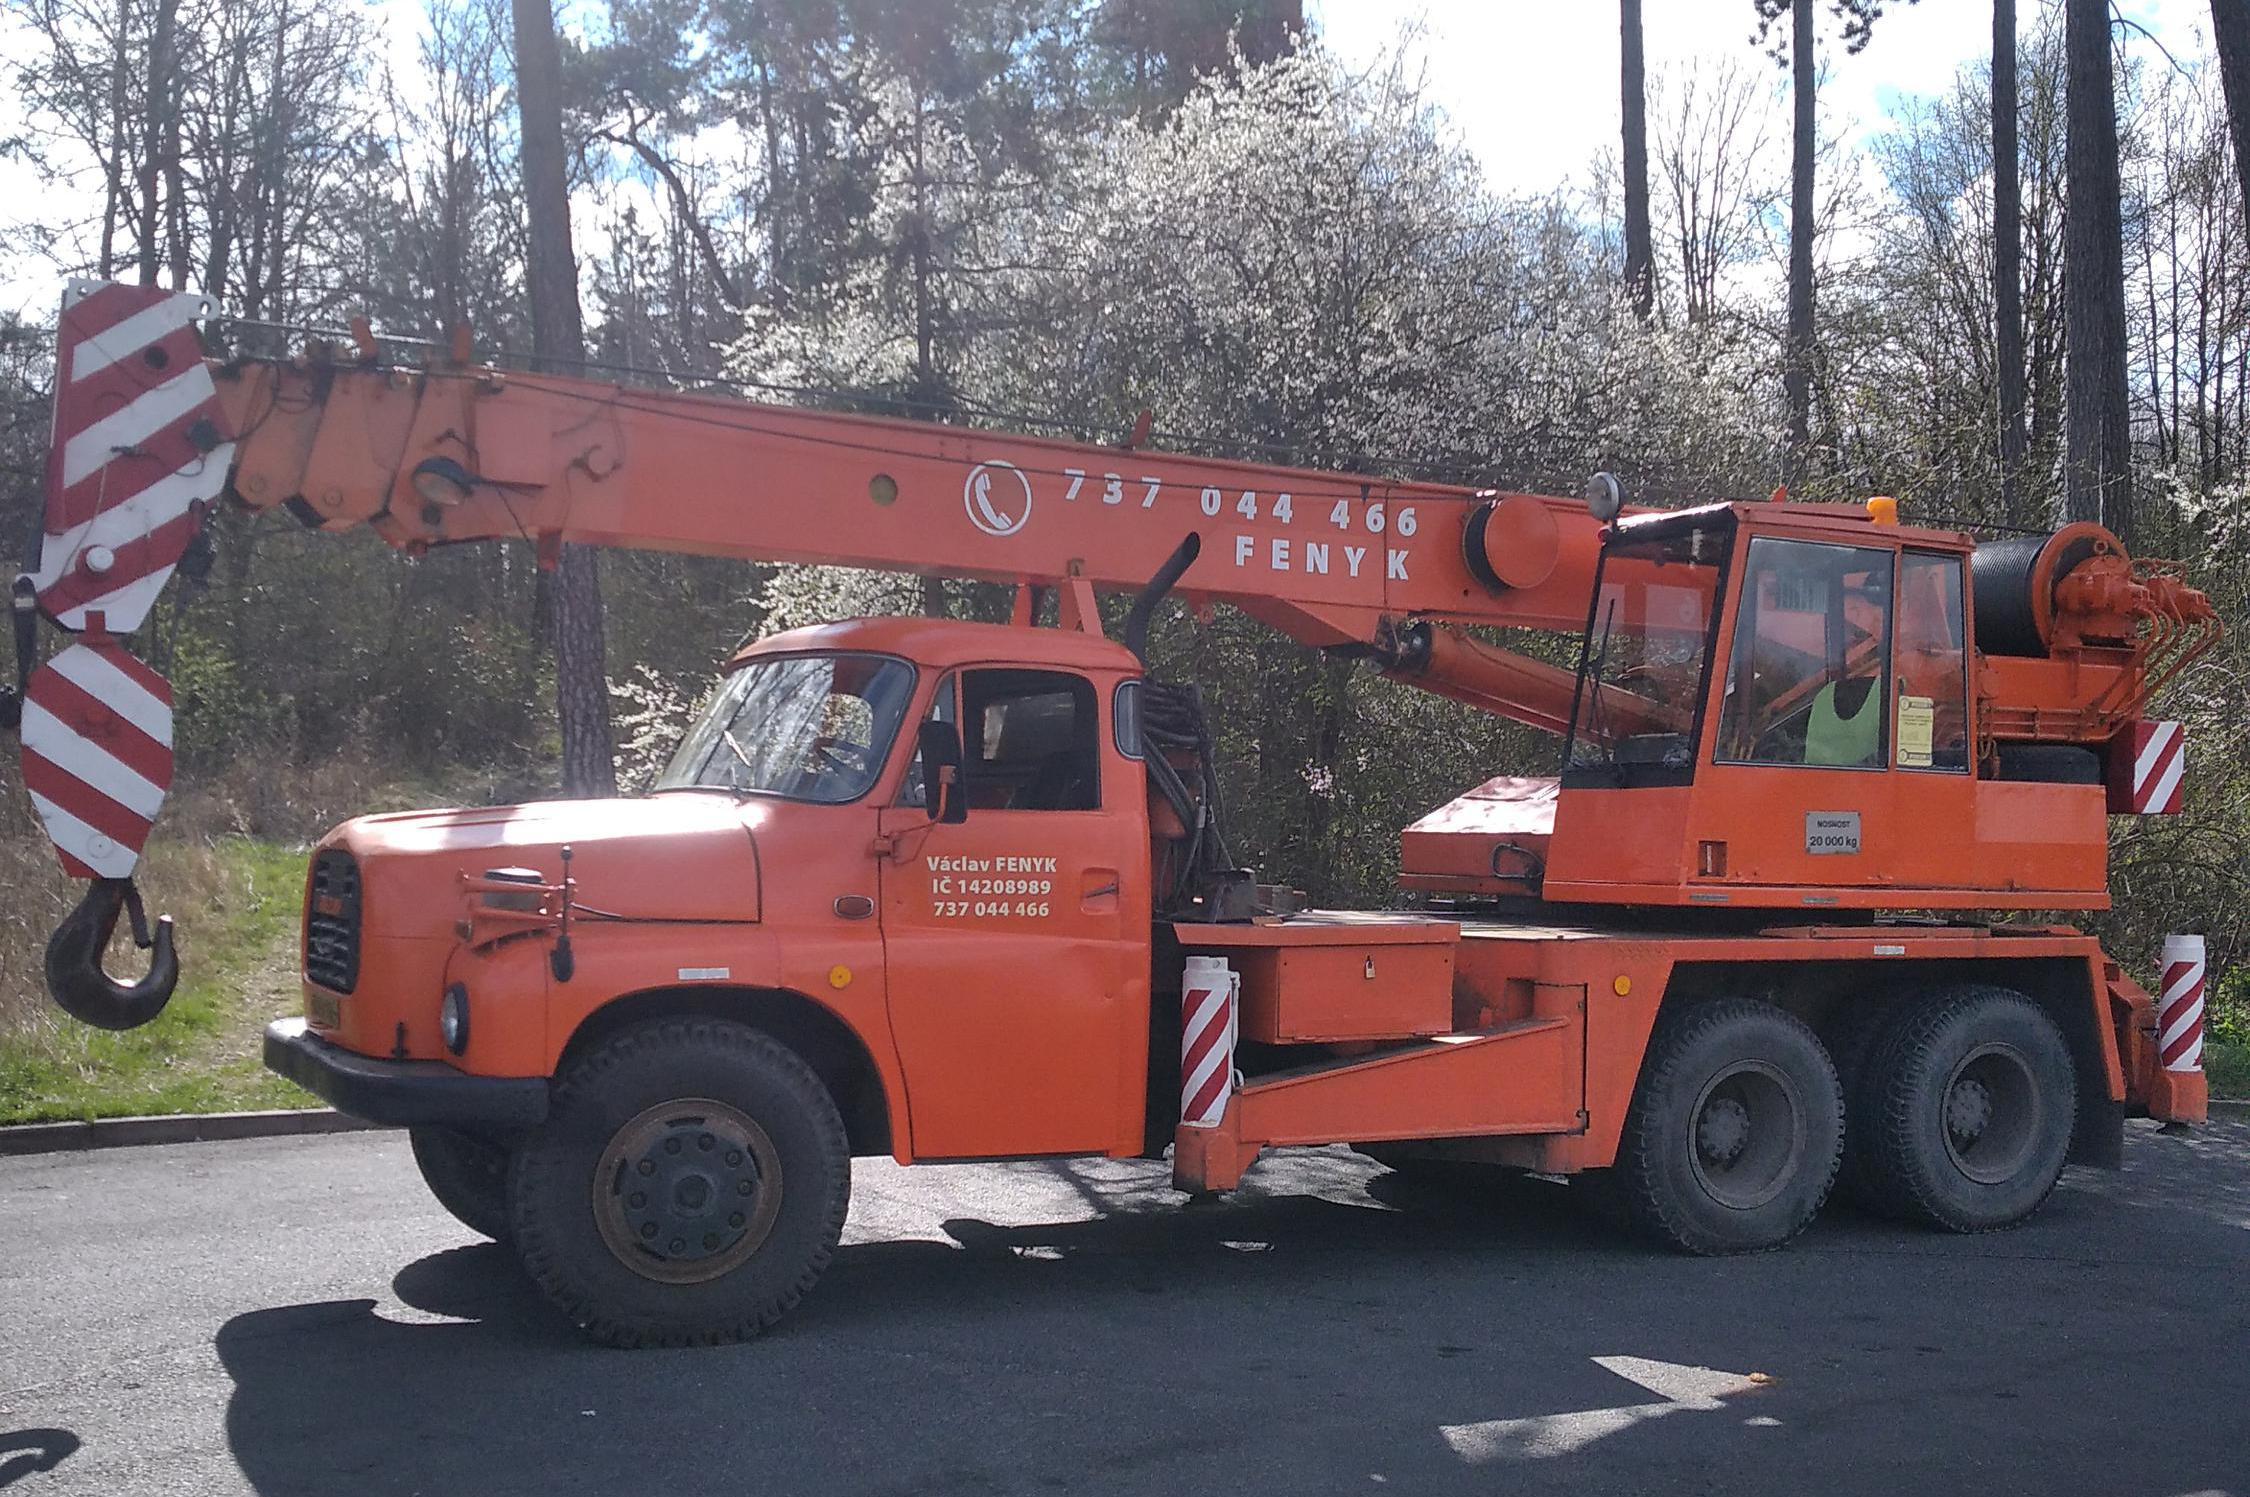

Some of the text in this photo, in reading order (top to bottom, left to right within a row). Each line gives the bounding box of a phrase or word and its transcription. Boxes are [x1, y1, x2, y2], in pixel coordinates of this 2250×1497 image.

[1063, 469, 1417, 537] 737 044 466
[1235, 536, 1409, 581] FENYK
[1817, 820, 1851, 828] NOSNOST
[1809, 836, 1857, 848] 20 000 kg
[926, 855, 1057, 873] Václav FENYK
[932, 876, 1051, 894] IČ 14208989
[934, 901, 1049, 917] 737 044 466
